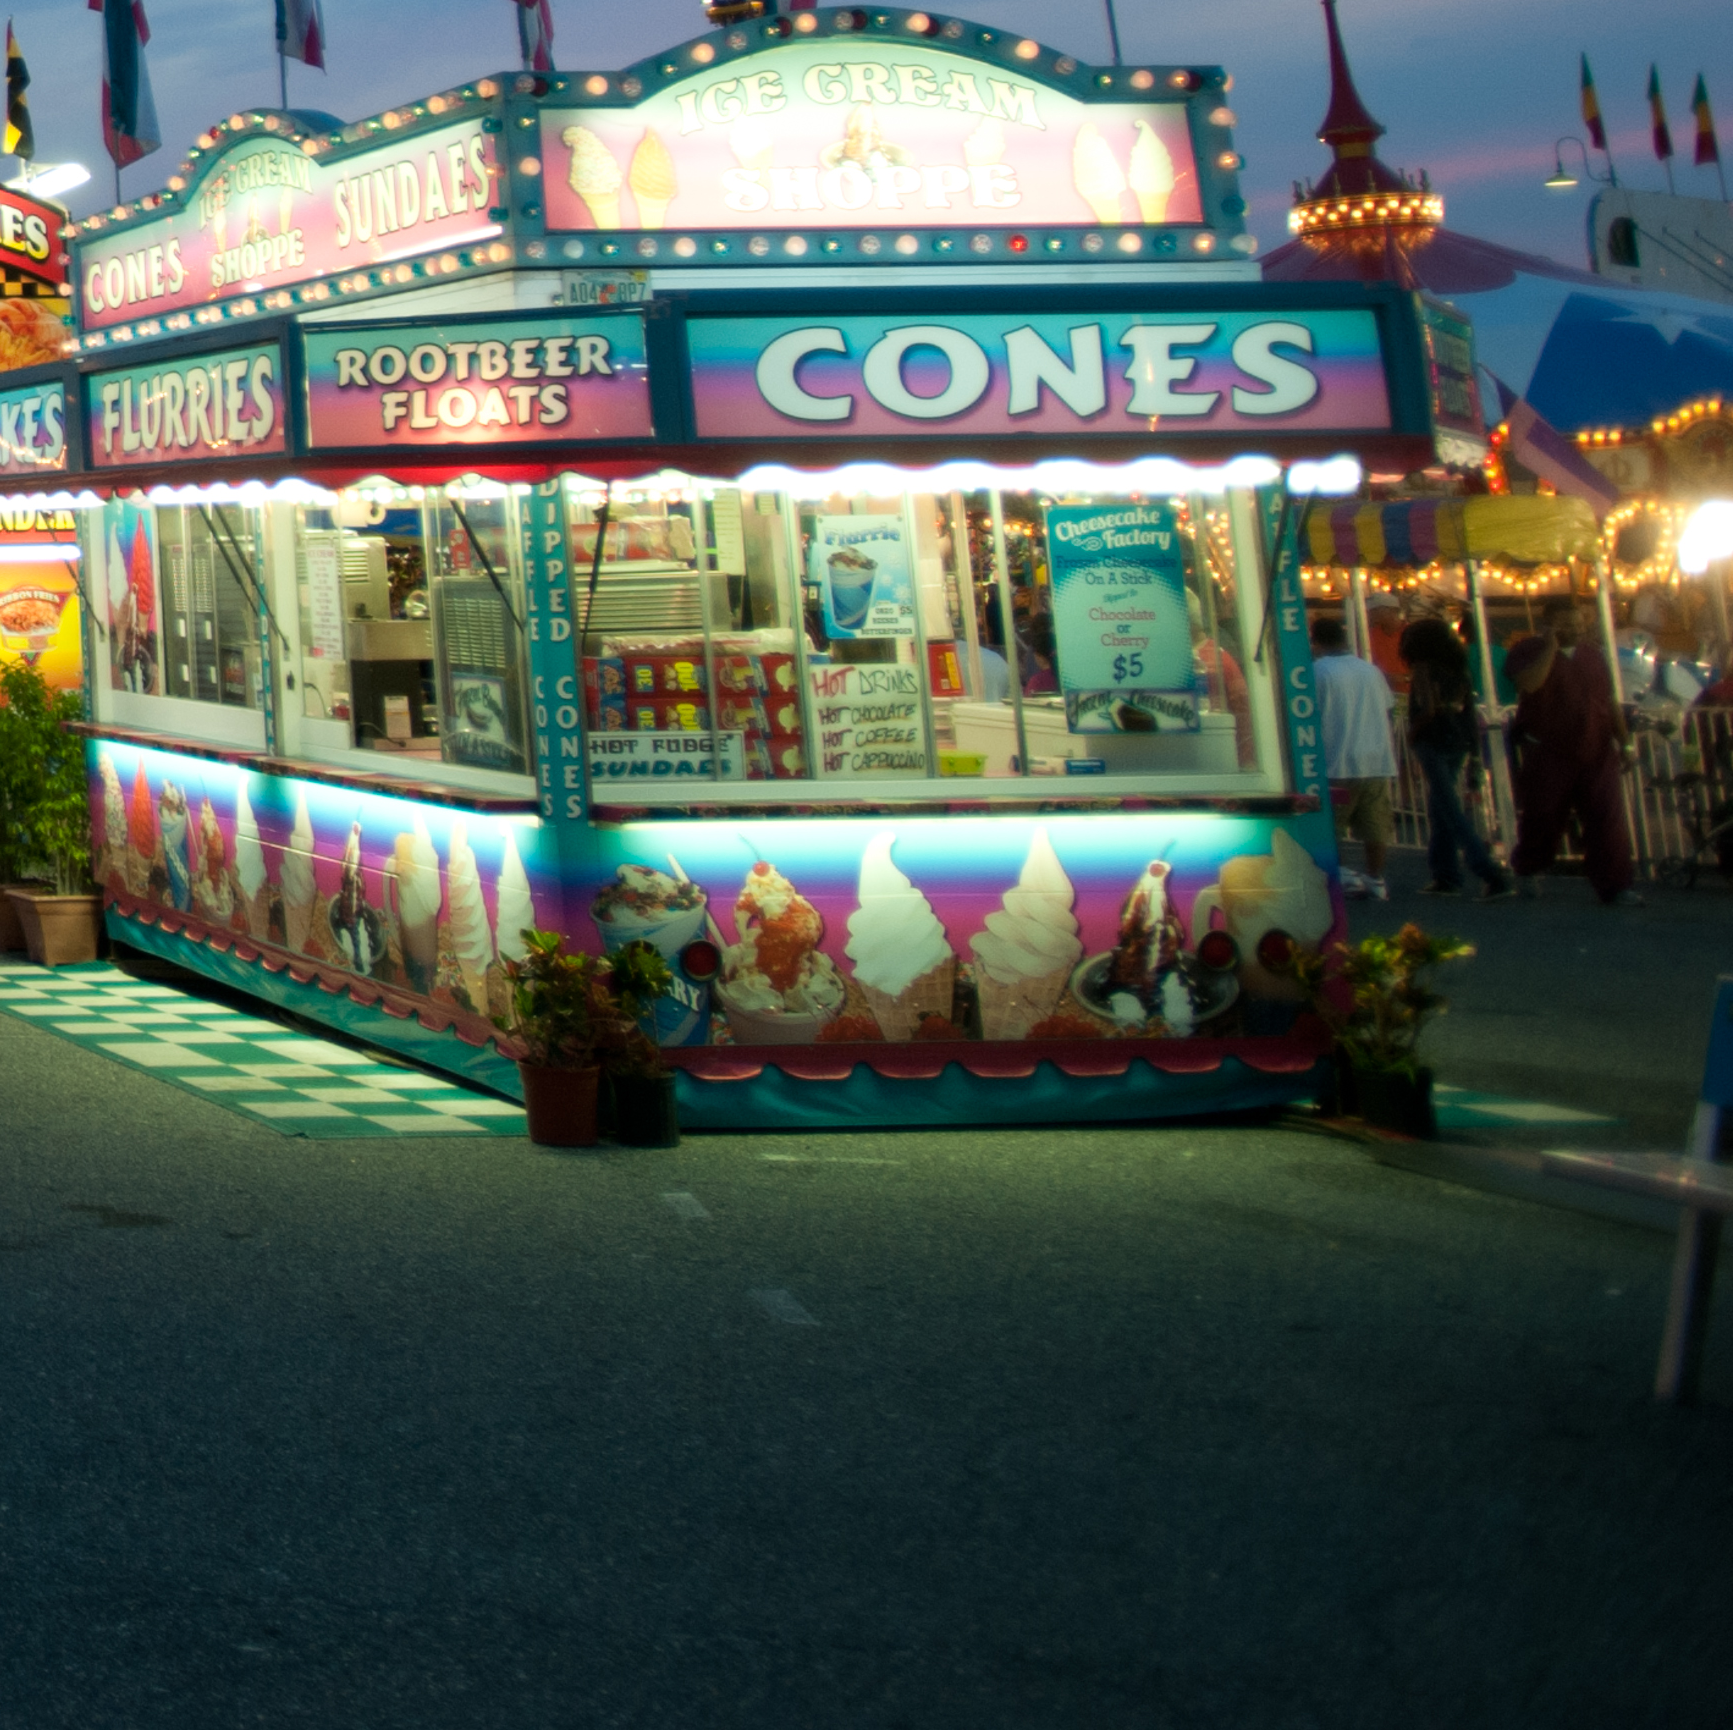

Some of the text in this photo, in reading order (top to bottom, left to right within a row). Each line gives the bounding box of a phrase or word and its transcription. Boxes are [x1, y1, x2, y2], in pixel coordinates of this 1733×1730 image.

[676, 62, 1047, 136] ICE CREAM
[199, 150, 313, 231] ICE CREAM
[334, 132, 489, 248] SUNDAES
[721, 162, 1022, 213] SHOPPE
[211, 227, 305, 288] SHOPPE
[86, 237, 186, 313] CONES
[335, 334, 616, 389] ROOTBEER
[755, 320, 1319, 422] CONES
[101, 354, 276, 457] FLURRIES
[380, 384, 571, 433] FLOATS
[1055, 507, 1160, 541] Cheesecake
[1102, 528, 1171, 551] Factory
[1102, 555, 1178, 568] Cheesecake
[1085, 572, 1152, 585] On A Stick
[1089, 607, 1156, 621] Chocolate
[1116, 624, 1132, 634] or
[538, 478, 582, 818] DIPPED CONES
[1100, 633, 1149, 649] Cherry
[521, 502, 553, 816] AFFLE CONES
[1113, 652, 1144, 684] $5
[811, 665, 856, 698] HOT
[818, 703, 916, 725] HOT CHOCOLATE
[590, 737, 730, 755] HOT FUDGE
[822, 727, 918, 749] HOT COFFEE
[591, 759, 732, 777] SUNDAES
[823, 751, 851, 773] HOT
